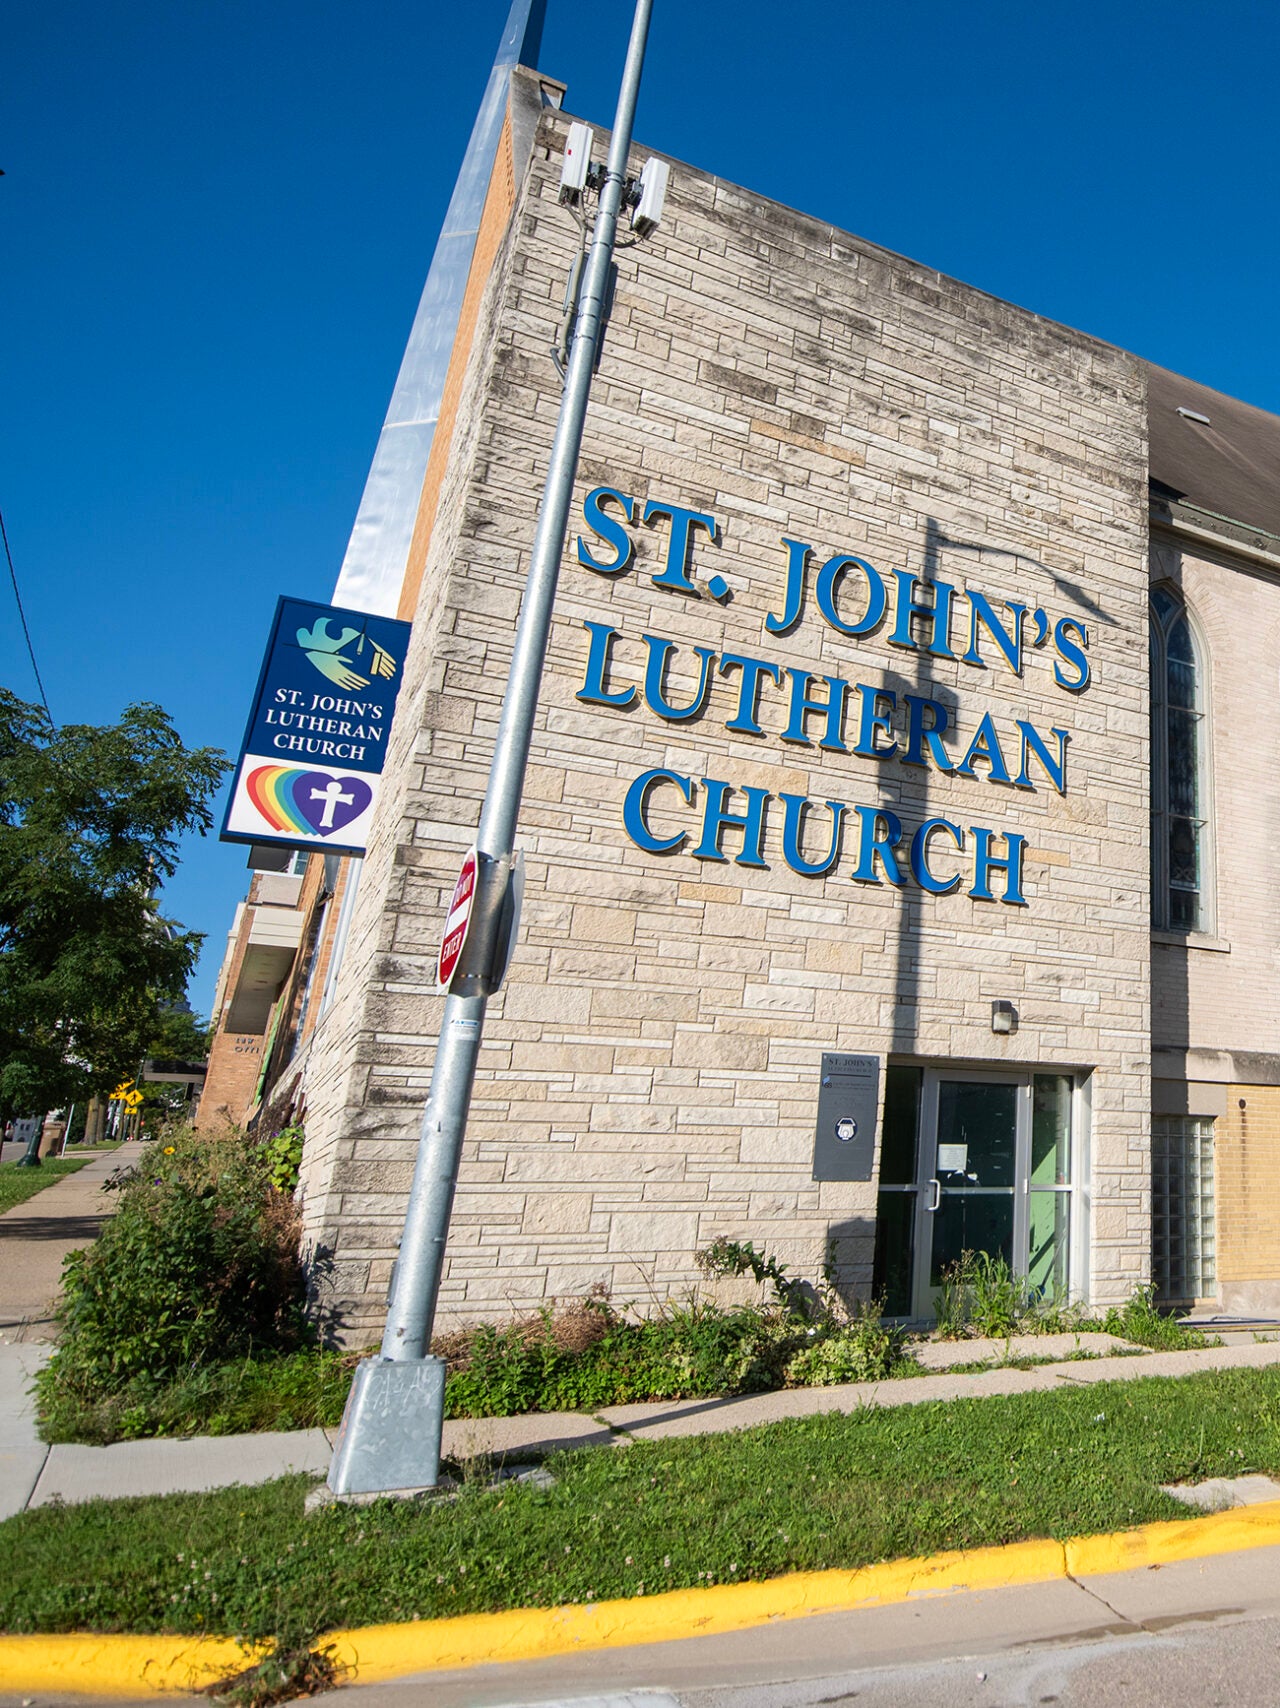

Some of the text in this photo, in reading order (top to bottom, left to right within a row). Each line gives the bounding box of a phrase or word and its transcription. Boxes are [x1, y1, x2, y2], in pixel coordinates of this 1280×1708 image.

[576, 485, 1092, 691] ST. JOHN'S
[265, 708, 383, 741] LUTHERAN
[274, 688, 383, 719] ST. JOHN'S
[575, 620, 1071, 795] LUTHERAN
[273, 733, 366, 761] CHURCH
[622, 768, 1027, 905] CHURCH
